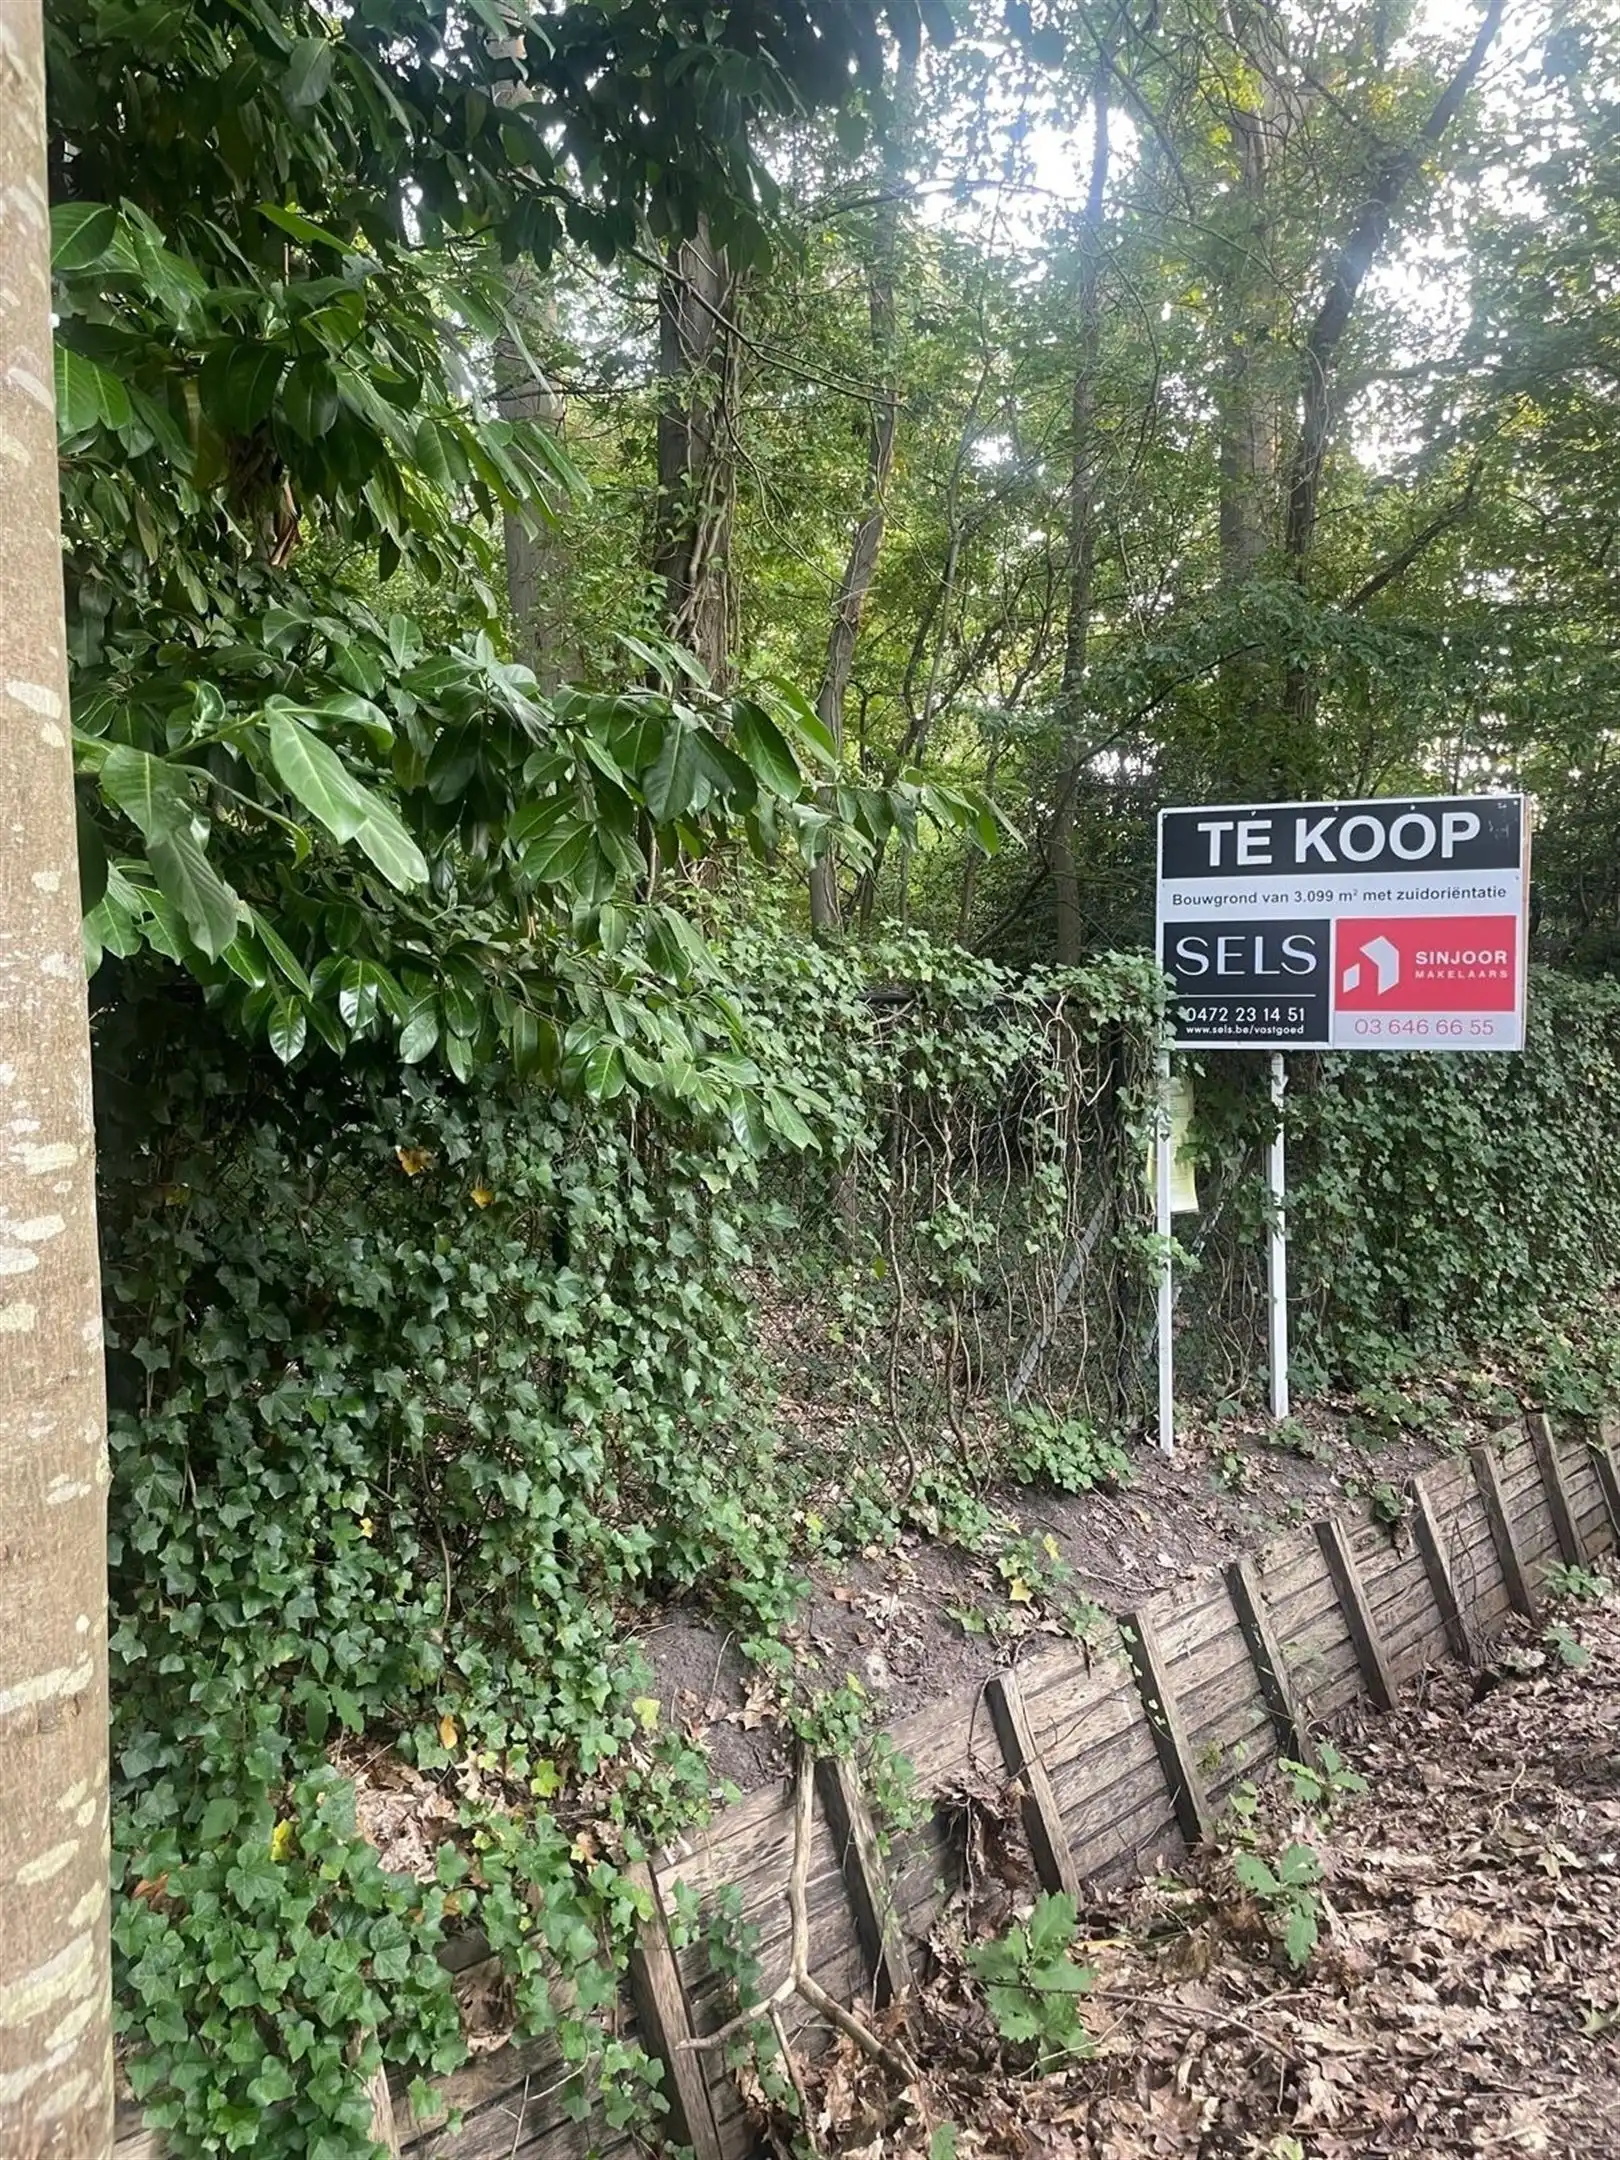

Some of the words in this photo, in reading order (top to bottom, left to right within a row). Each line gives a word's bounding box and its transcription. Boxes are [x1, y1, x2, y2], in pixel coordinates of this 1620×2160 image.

[1197, 820, 1273, 867] TE
[1295, 811, 1481, 863] KOOP
[1172, 893, 1258, 908] Bouwgrond
[1262, 893, 1289, 903] van
[1294, 890, 1334, 903] 3.099
[1362, 888, 1392, 901] met
[1396, 886, 1507, 901] zuidoriëntatie
[1175, 934, 1318, 976] SELS
[1415, 950, 1508, 965] SINJOOR
[1415, 969, 1509, 979] MAKELAARS
[1185, 1007, 1229, 1022] 0472
[1235, 1007, 1257, 1022] 23
[1262, 1007, 1281, 1022] 14
[1287, 1007, 1305, 1022] 51
[1185, 1023, 1305, 1036] www.sels.be/vastgoed
[1354, 1019, 1381, 1035] 03
[1388, 1018, 1429, 1035] 646
[1435, 1018, 1462, 1035] 66
[1469, 1018, 1494, 1035] 55
